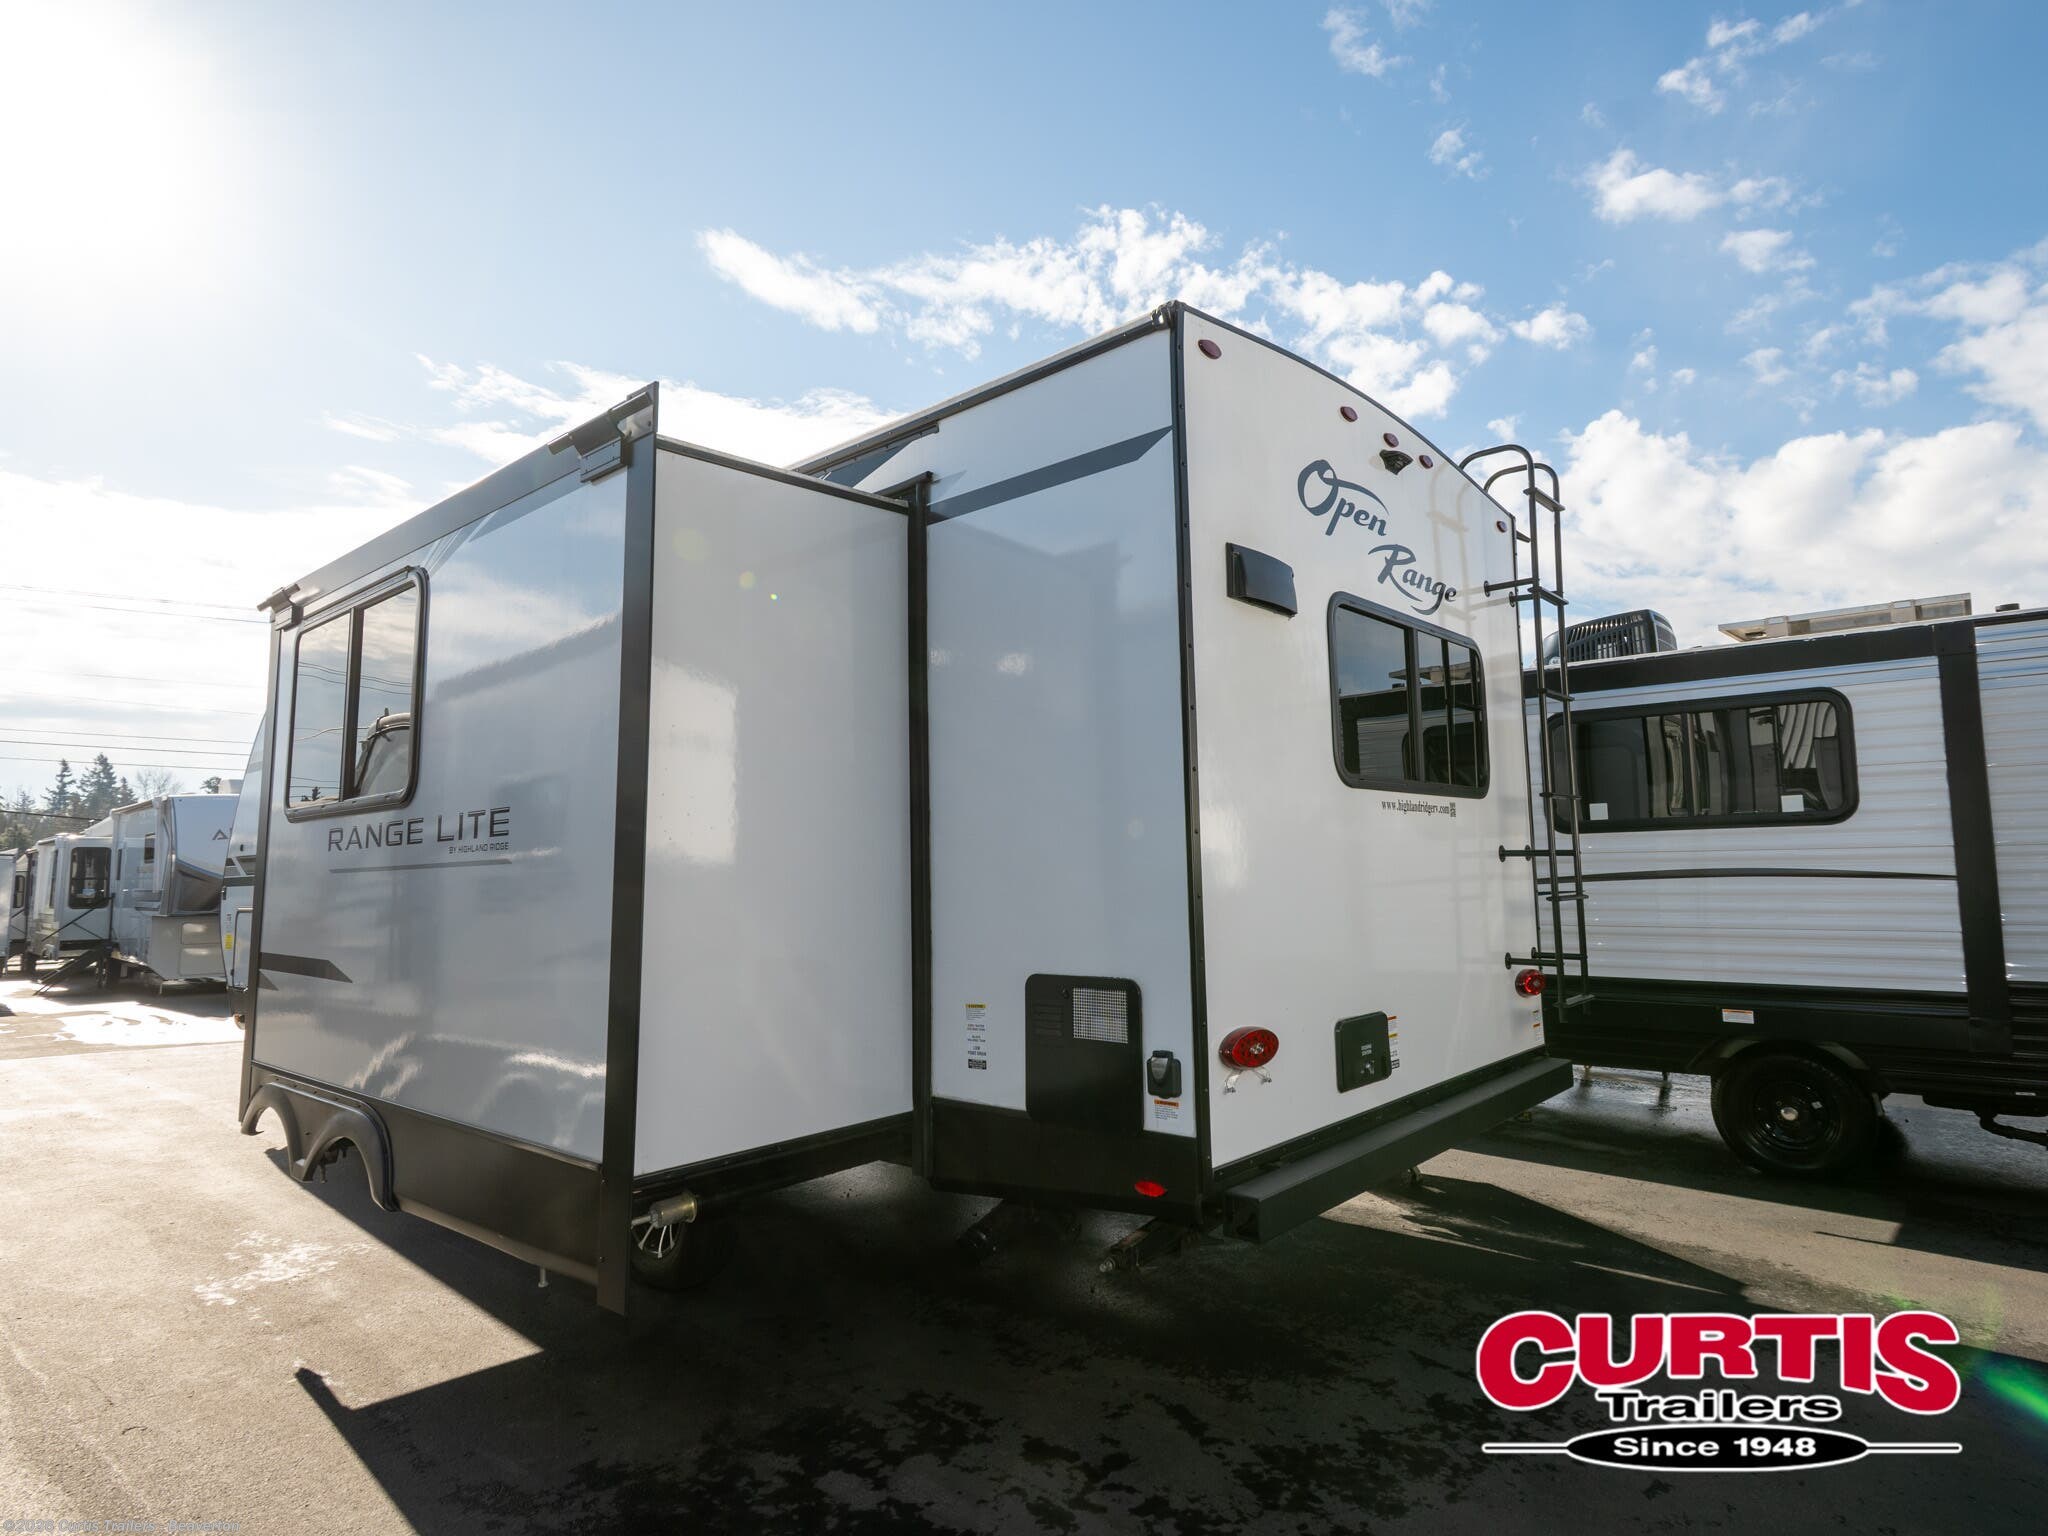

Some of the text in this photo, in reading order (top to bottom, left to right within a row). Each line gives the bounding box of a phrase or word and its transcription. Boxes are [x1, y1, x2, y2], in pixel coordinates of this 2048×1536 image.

[1297, 459, 1389, 536] Open
[1367, 543, 1457, 616] Range
[328, 806, 511, 852] RANGE LITE
[1381, 799, 1450, 816] www.highlandridgerv.com
[458, 843, 489, 854] HIGHLAND
[489, 841, 510, 852] RIDGE
